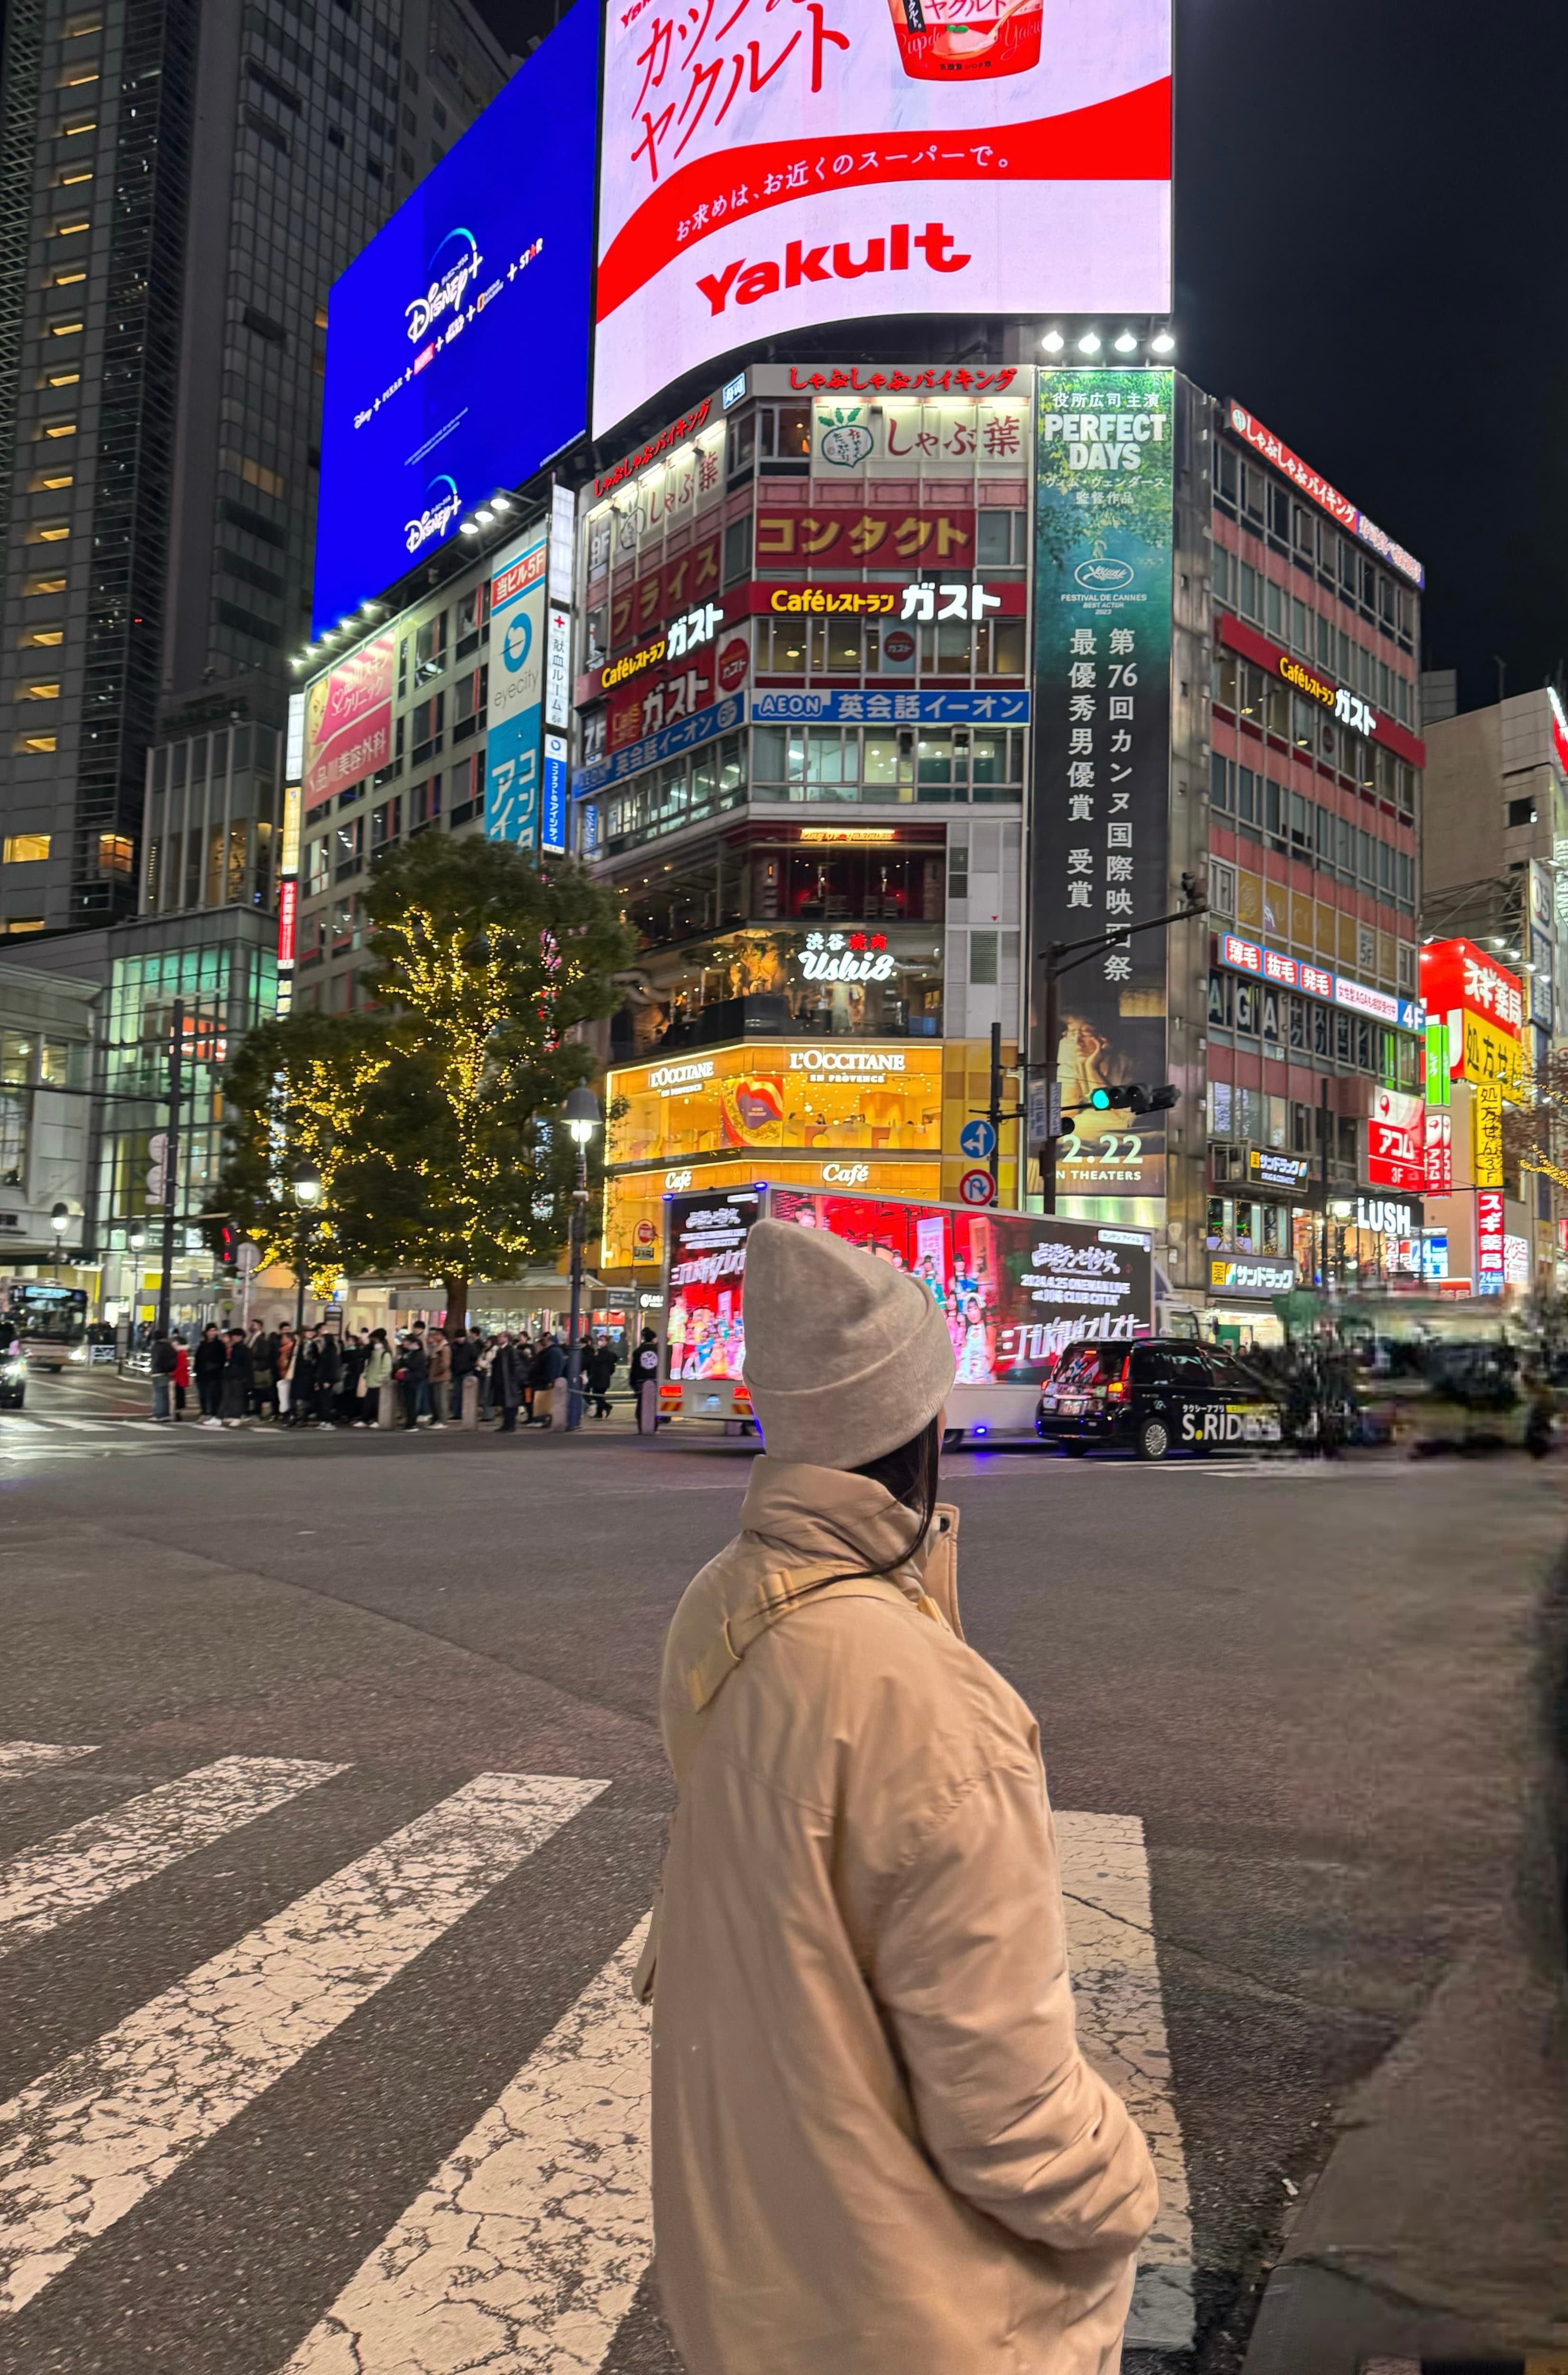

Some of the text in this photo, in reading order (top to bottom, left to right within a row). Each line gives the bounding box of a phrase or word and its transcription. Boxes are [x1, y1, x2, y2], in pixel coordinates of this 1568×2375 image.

[631, 2, 850, 182] ヤクルト
[676, 145, 1009, 241] お求めは、お近くのスーパーで。
[696, 223, 972, 317] Yakult
[790, 367, 1018, 390] しゃぶしゃぶバイキング
[1052, 393, 1159, 408] 役所広司 主演
[888, 415, 1020, 457] しゃぶ葉
[1045, 414, 1166, 441] PERFECT
[594, 398, 711, 497] しゃぶしゃぶバイキング
[1069, 443, 1141, 470] DAYS
[1046, 476, 1166, 488] ヴィム・ヴェンダース
[1247, 415, 1357, 523] しゃぶしゃぶバイキング
[651, 452, 718, 523] しゃぶ葉
[1076, 492, 1134, 505] 監督作品
[758, 516, 969, 557] コンタクト
[497, 551, 544, 601] 当ビル5F
[770, 582, 1001, 620] Caféレストラン ガスト
[1114, 594, 1147, 602] CANNES
[601, 602, 724, 688] Caféレストラン ガスト
[494, 667, 539, 709] eyecity
[642, 669, 709, 738] ガスト
[762, 694, 1023, 720] AEON 英会話イーオン
[1335, 687, 1376, 736] ガスト
[584, 720, 606, 755] 7F
[616, 713, 713, 778] 英会話イーオン
[1067, 628, 1097, 908] 最優秀男優賞 受賞
[1104, 628, 1138, 981] 第76回カンヌ国際映画祭
[806, 932, 887, 951] 渋谷焼肉
[798, 950, 895, 981] Ushi8
[1228, 939, 1258, 970] 薄毛
[1266, 952, 1295, 983] 抜毛
[1303, 965, 1330, 996] 発毛
[1402, 1003, 1424, 1031] 4F
[789, 1050, 906, 1070] L'OCCITANE
[810, 1074, 885, 1083] EN PROVENCE
[1061, 1134, 1143, 1164] 2.22
[1379, 1127, 1414, 1159] アコム
[665, 1170, 691, 1190] Café
[822, 1163, 869, 1187] Café
[1070, 1170, 1142, 1180] THEATERS
[1391, 1167, 1403, 1183] 3F
[1428, 1149, 1441, 1180] アコム
[1357, 1197, 1410, 1236] LUSH
[1480, 1195, 1503, 1270] スギ薬局
[1237, 1265, 1294, 1289] サンドラッグ
[1182, 1405, 1225, 1414] タクシーアプリ
